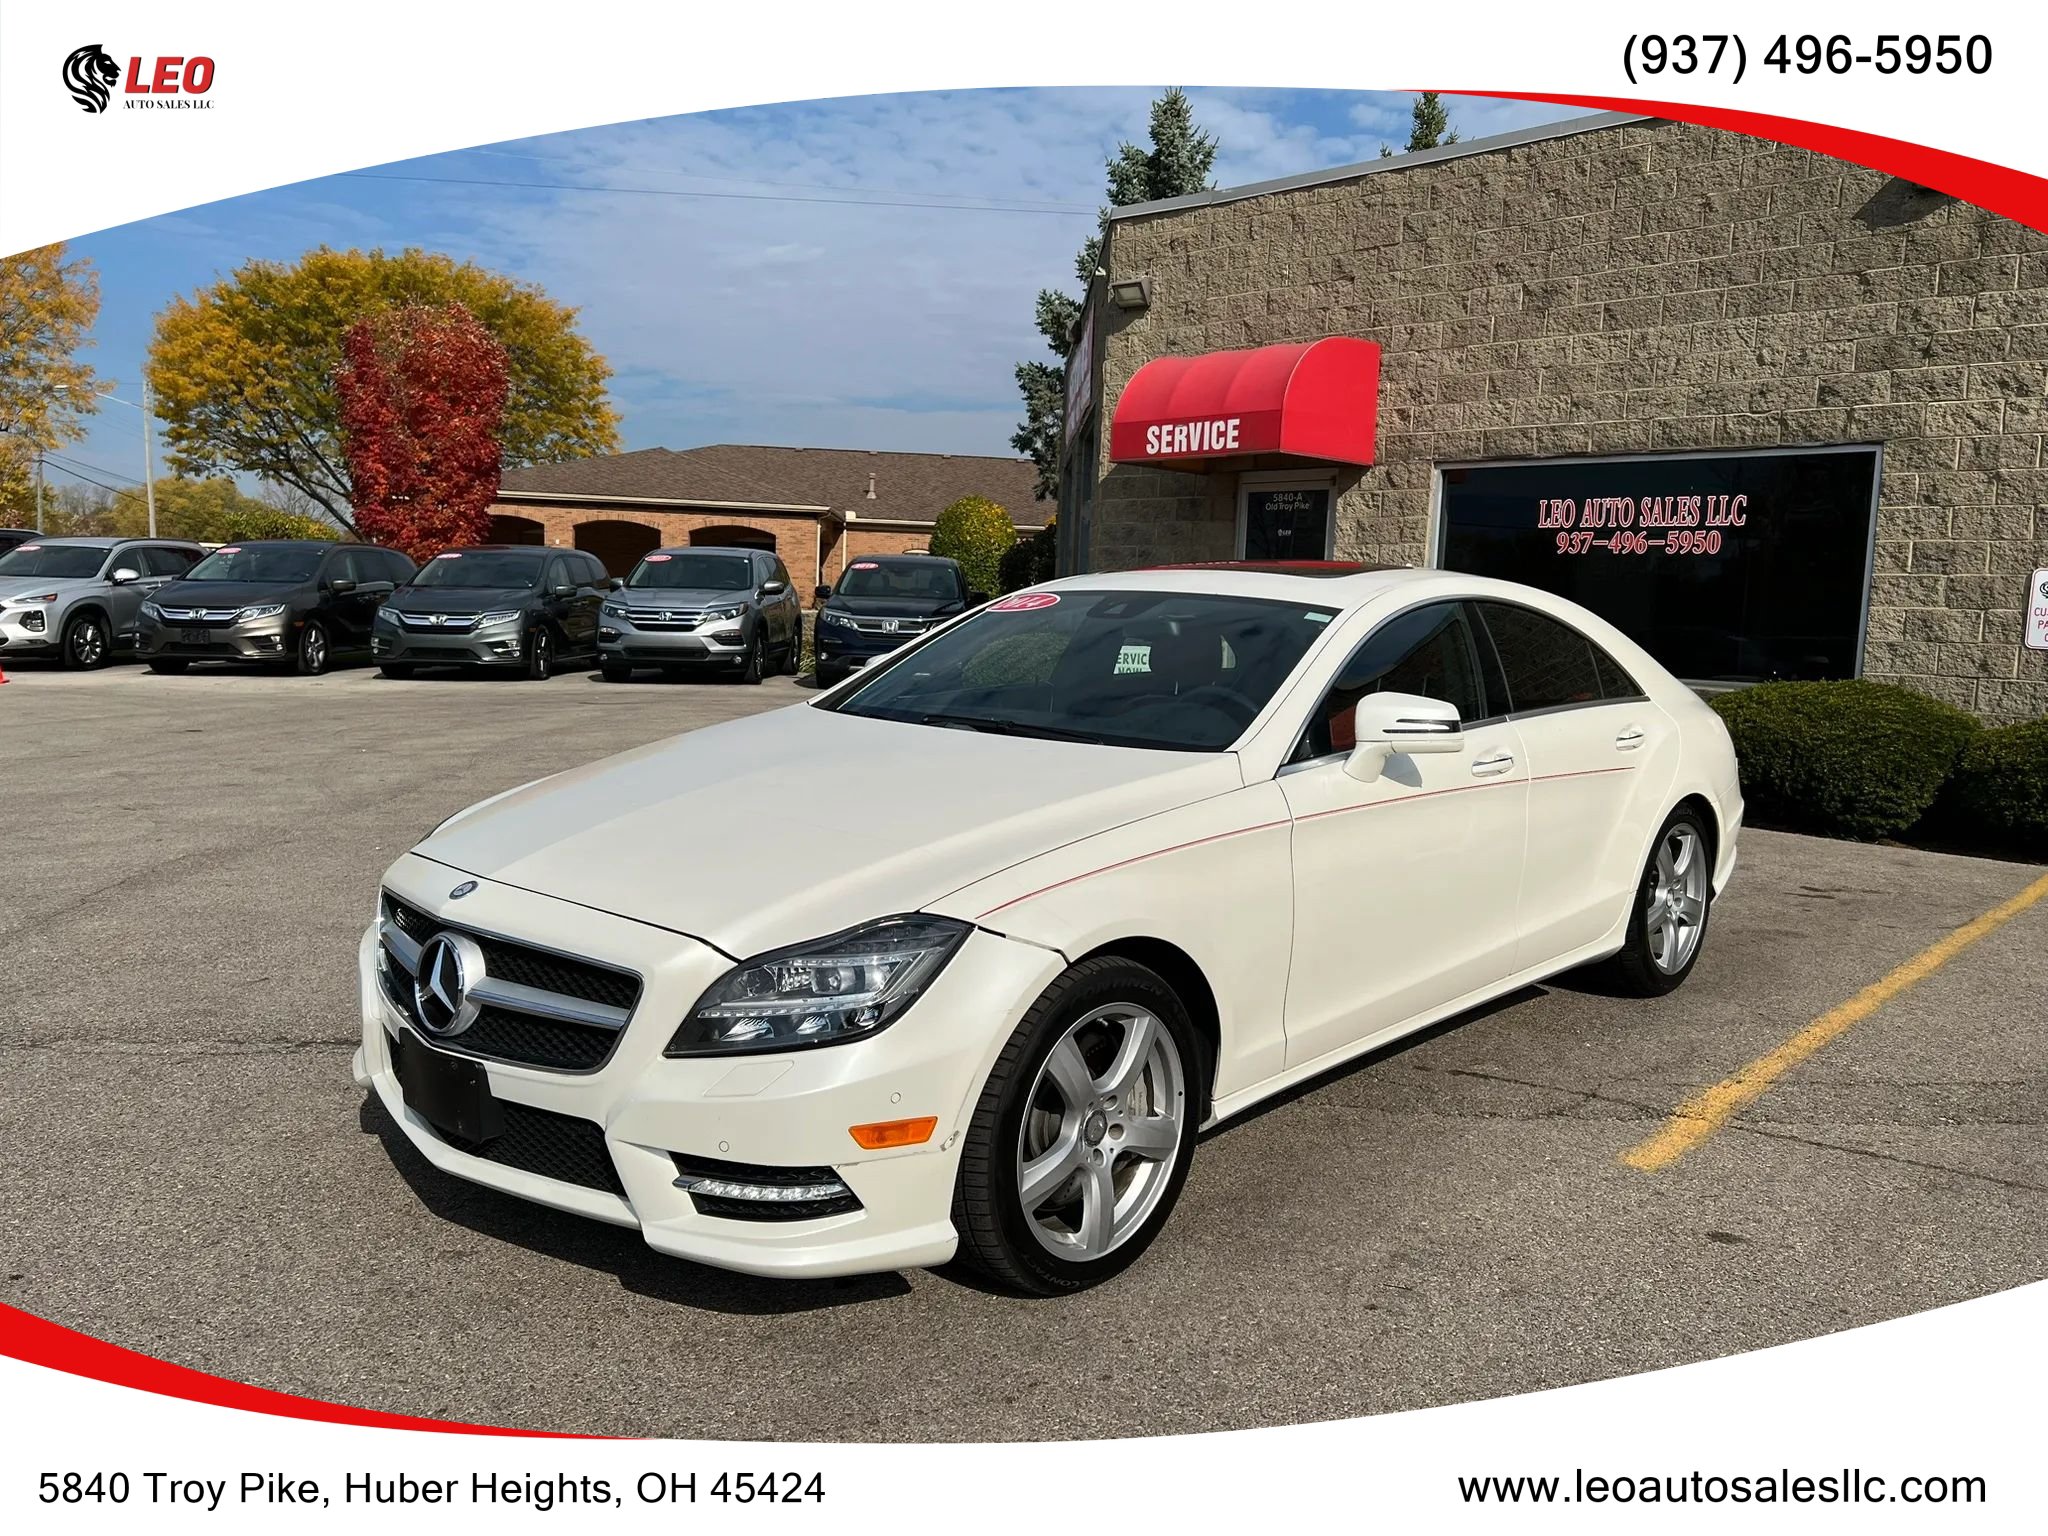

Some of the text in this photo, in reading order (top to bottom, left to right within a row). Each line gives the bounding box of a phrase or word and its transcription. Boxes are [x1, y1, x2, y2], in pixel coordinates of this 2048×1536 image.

[1145, 418, 1241, 455] SERVICE
[1273, 492, 1303, 502] 5840-A
[1265, 502, 1278, 511] Old
[1279, 502, 1293, 512] Troy
[1538, 494, 1748, 529] LEO AUTO SALES LLC
[1556, 530, 1722, 555] 937-496-5950
[2034, 607, 2048, 617] CU
